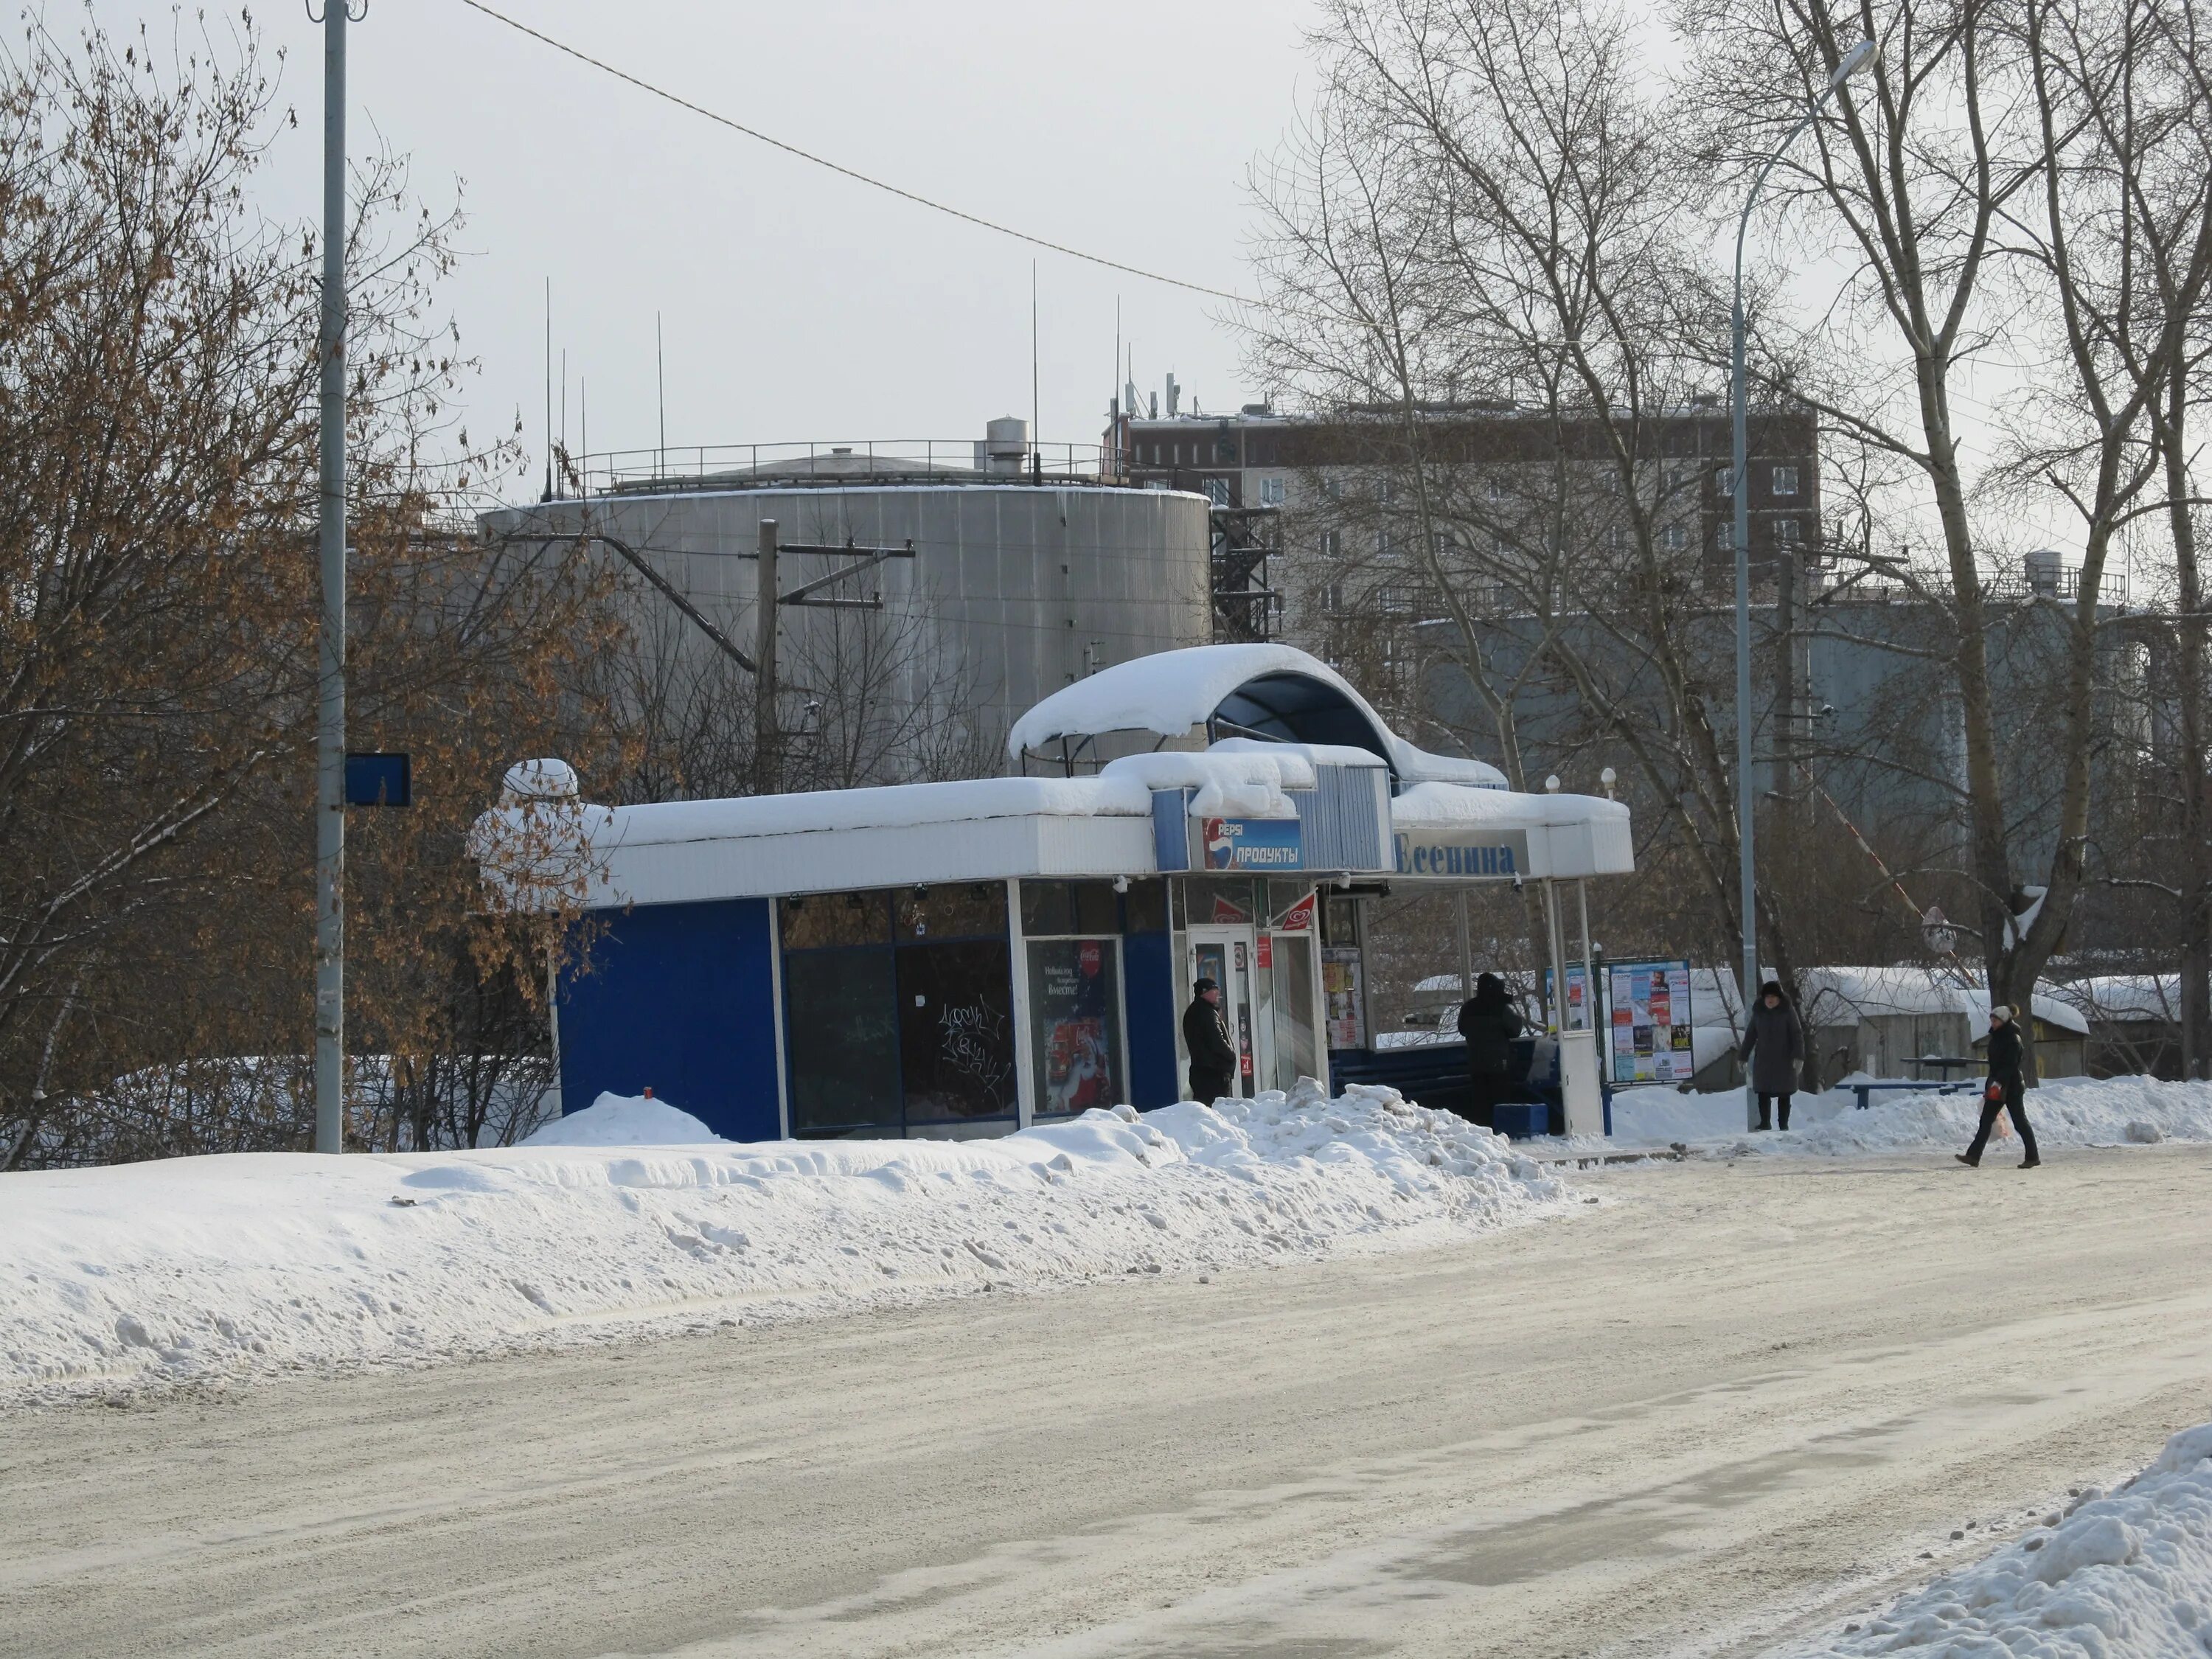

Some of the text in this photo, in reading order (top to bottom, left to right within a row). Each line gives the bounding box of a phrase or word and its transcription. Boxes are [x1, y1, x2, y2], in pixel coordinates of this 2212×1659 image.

[1218, 824, 1243, 836] PEPSI
[1237, 846, 1298, 863] ПРОДУКТЫ
[1394, 832, 1516, 874] Есенина
